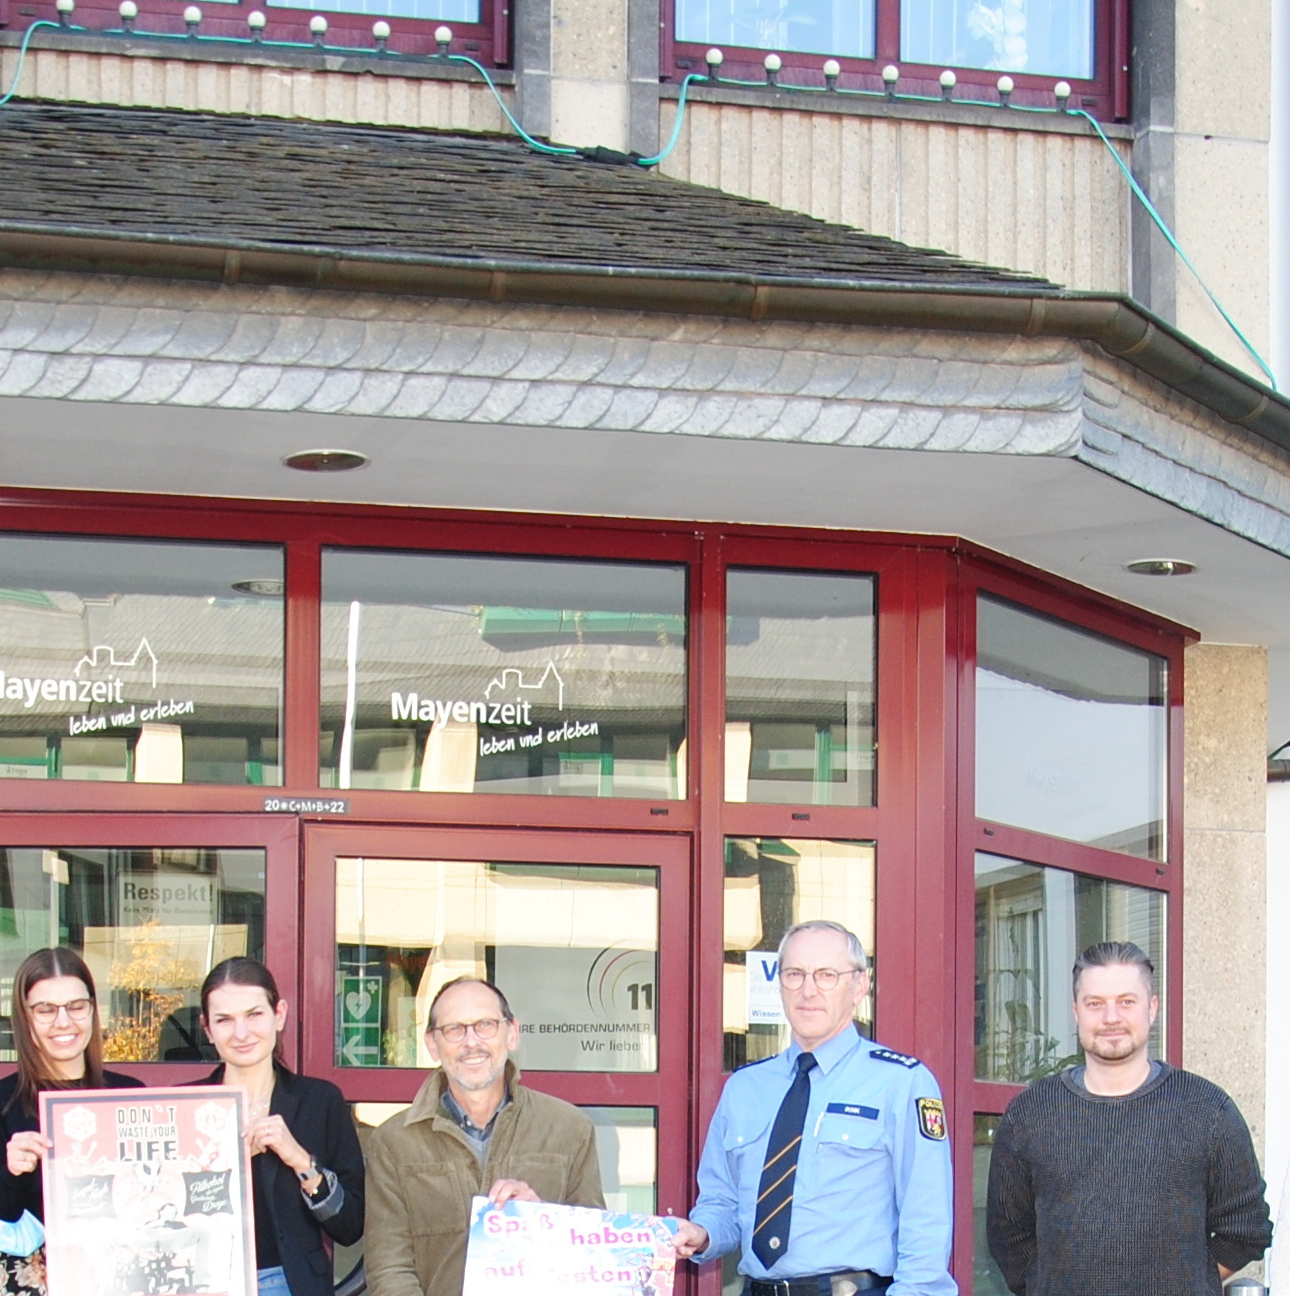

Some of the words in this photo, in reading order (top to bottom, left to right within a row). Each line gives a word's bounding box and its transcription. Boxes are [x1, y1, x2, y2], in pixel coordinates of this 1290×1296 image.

[69, 716, 107, 736] leben
[111, 705, 135, 728] und
[139, 699, 194, 723] erleben
[390, 691, 532, 729] Mayenzeit
[479, 737, 515, 757] leben
[520, 727, 543, 748] und
[547, 720, 599, 743] erleben
[124, 882, 213, 904] Respekt!
[751, 1010, 781, 1018] Wissen
[539, 1022, 651, 1034] BEHÖRDENNUMMER
[581, 1040, 606, 1051] Wir
[118, 1128, 149, 1138] WASTE
[153, 1126, 176, 1137] YOUR
[119, 1140, 177, 1162] LIFE
[488, 1213, 554, 1237] Spß
[570, 1226, 651, 1246] haben
[485, 1257, 525, 1278] auf
[551, 1264, 631, 1285] esten
